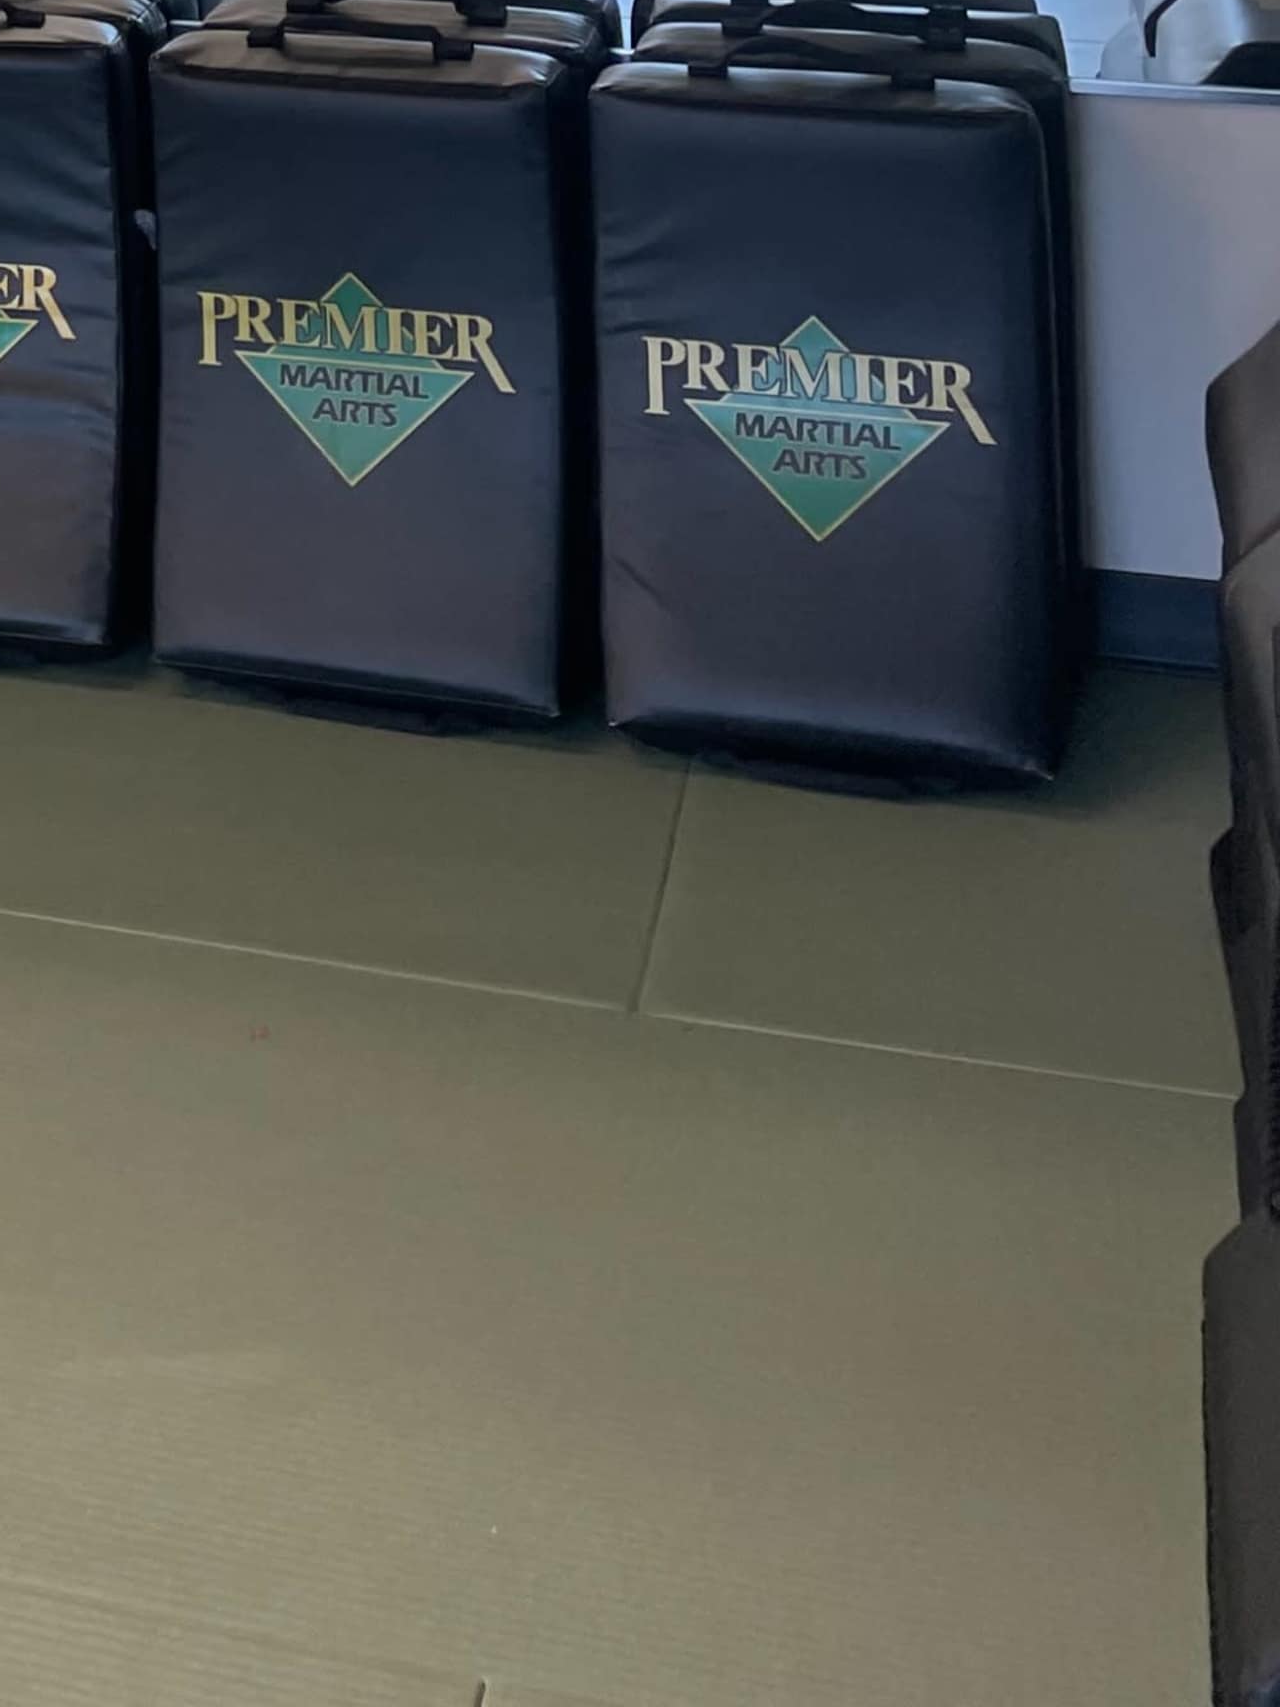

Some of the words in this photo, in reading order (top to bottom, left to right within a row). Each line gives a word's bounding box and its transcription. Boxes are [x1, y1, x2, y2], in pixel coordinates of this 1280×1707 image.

[196, 290, 517, 394] PREMIER
[279, 363, 430, 399] MARTIAL
[642, 336, 999, 446] PREMIER
[311, 397, 398, 427] ARTS
[734, 412, 902, 451] MARTIAL
[772, 449, 867, 480] ARTS
